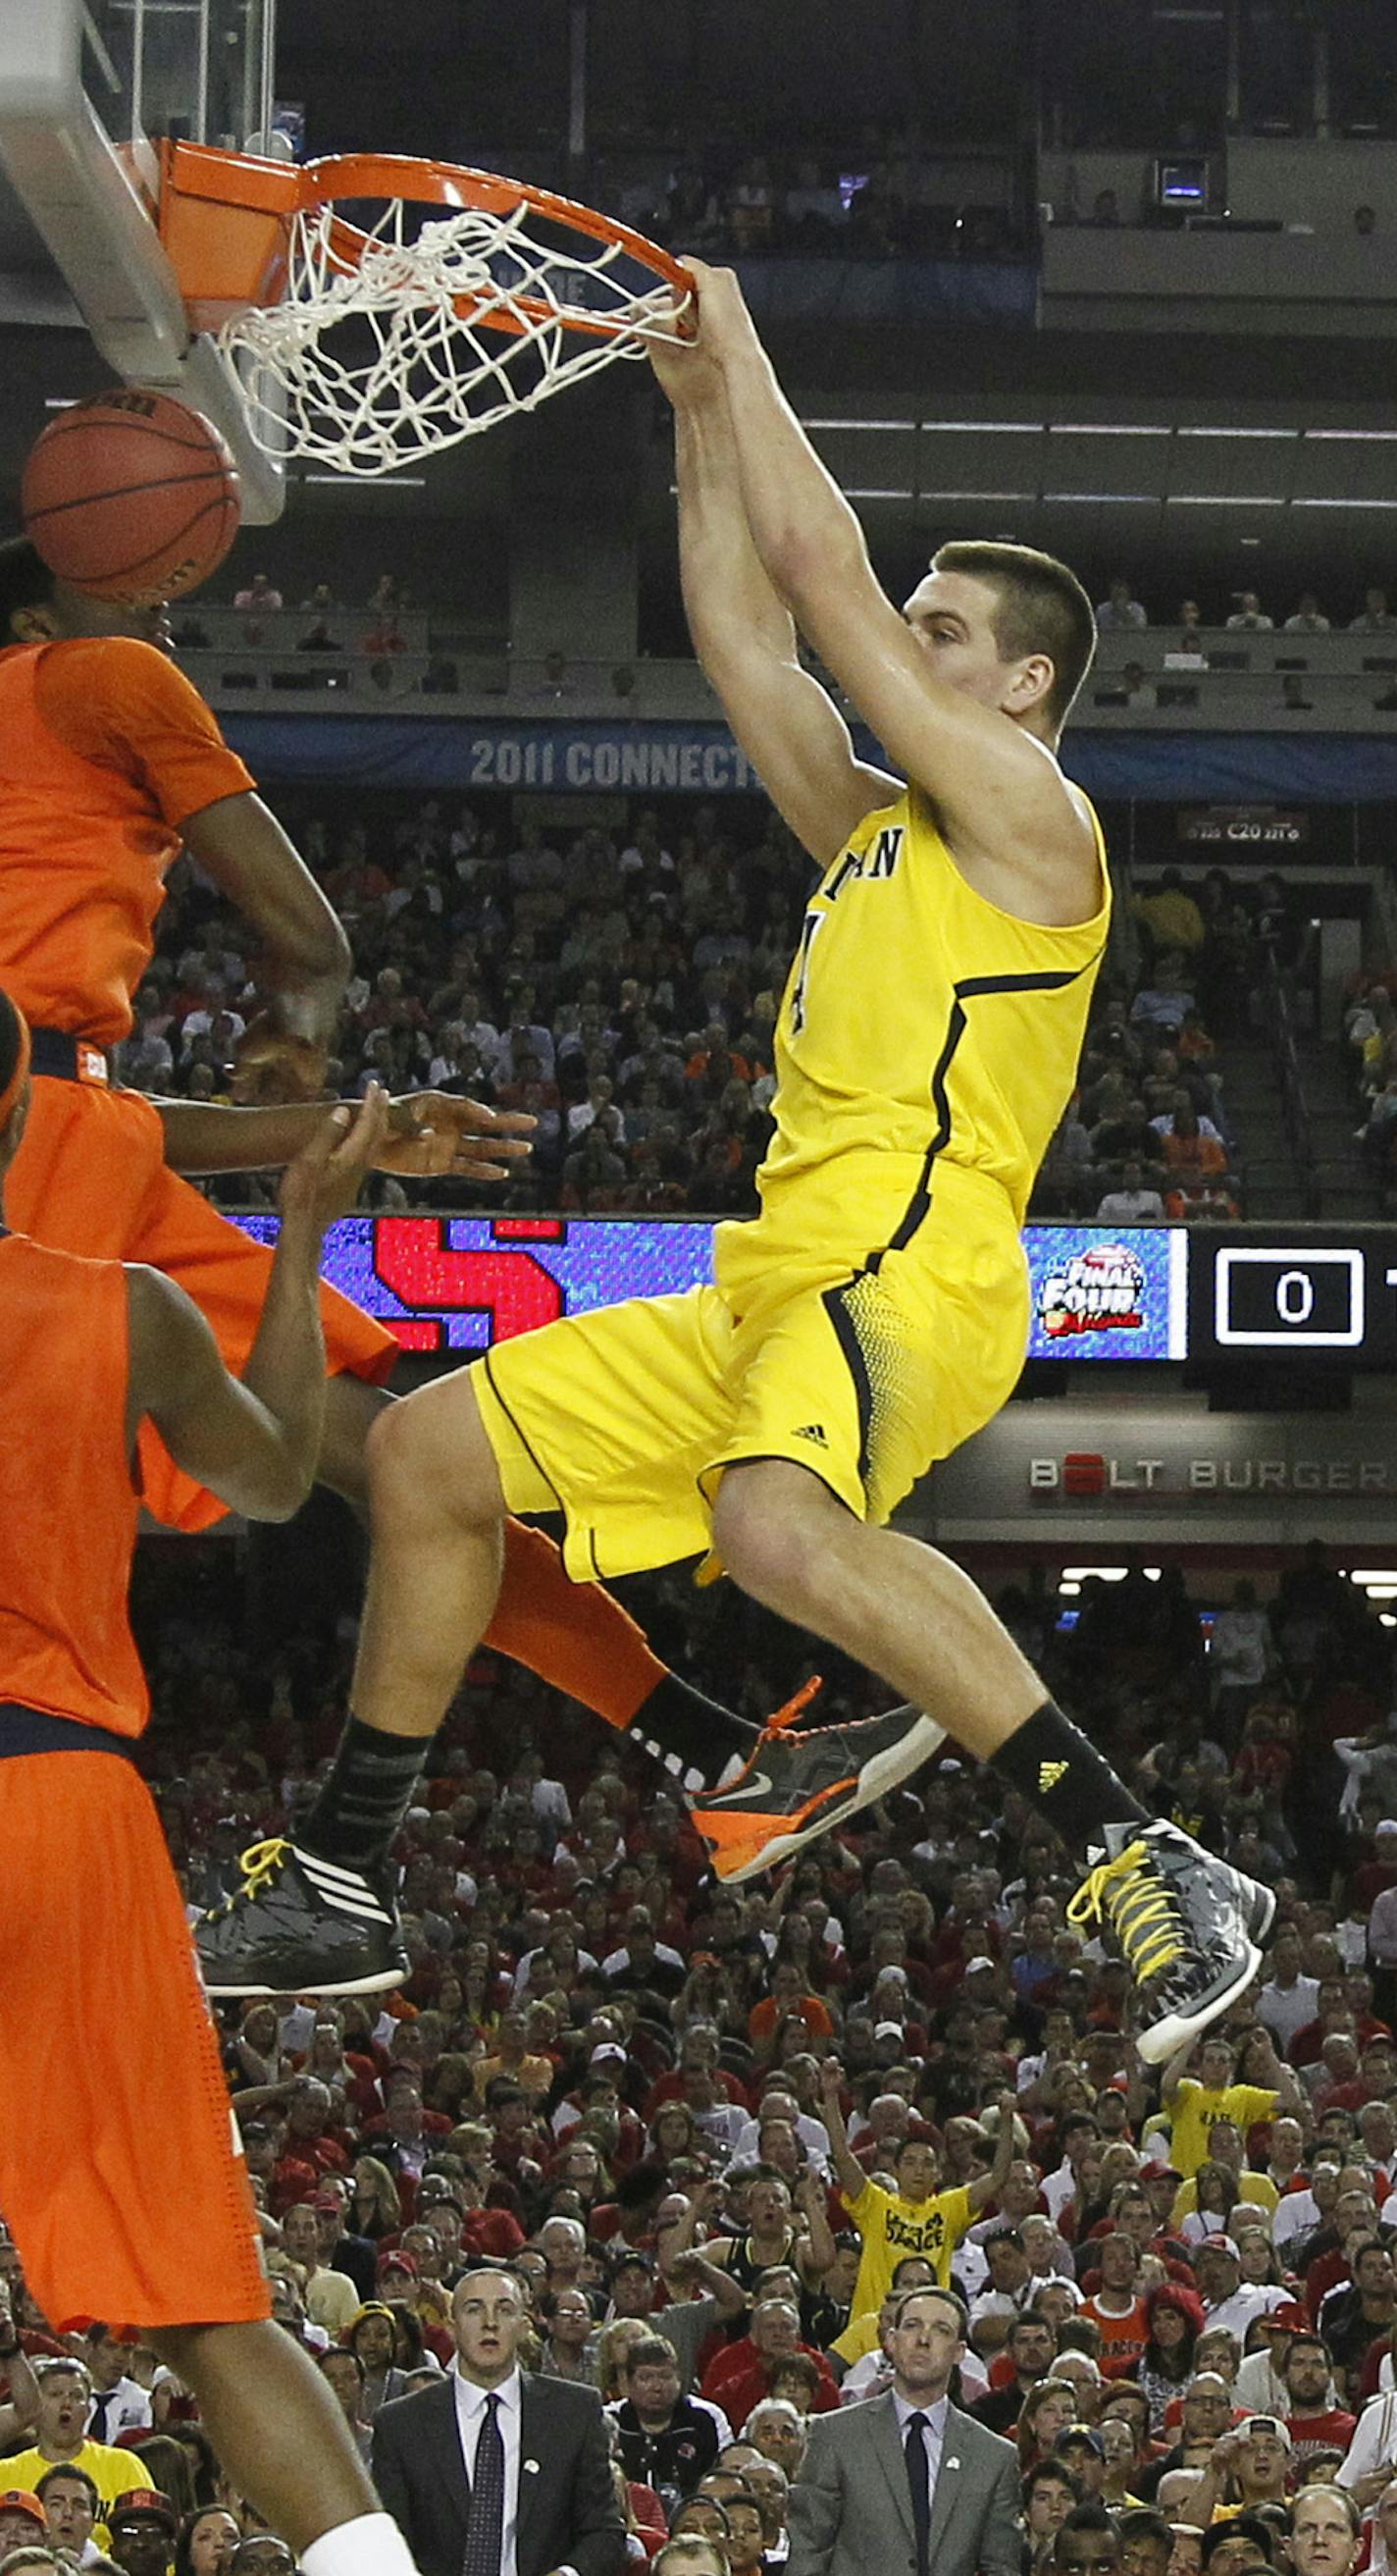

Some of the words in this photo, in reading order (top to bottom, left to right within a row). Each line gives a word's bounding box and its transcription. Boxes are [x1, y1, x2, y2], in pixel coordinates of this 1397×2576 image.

[471, 740, 554, 784] 2011
[566, 741, 764, 788] CONNECT
[1227, 823, 1262, 839] C20
[1068, 1259, 1136, 1288] FINAL
[1042, 1278, 1137, 1315] FOUR
[1276, 1270, 1314, 1324] 0
[1189, 1458, 1387, 1491] BURGER
